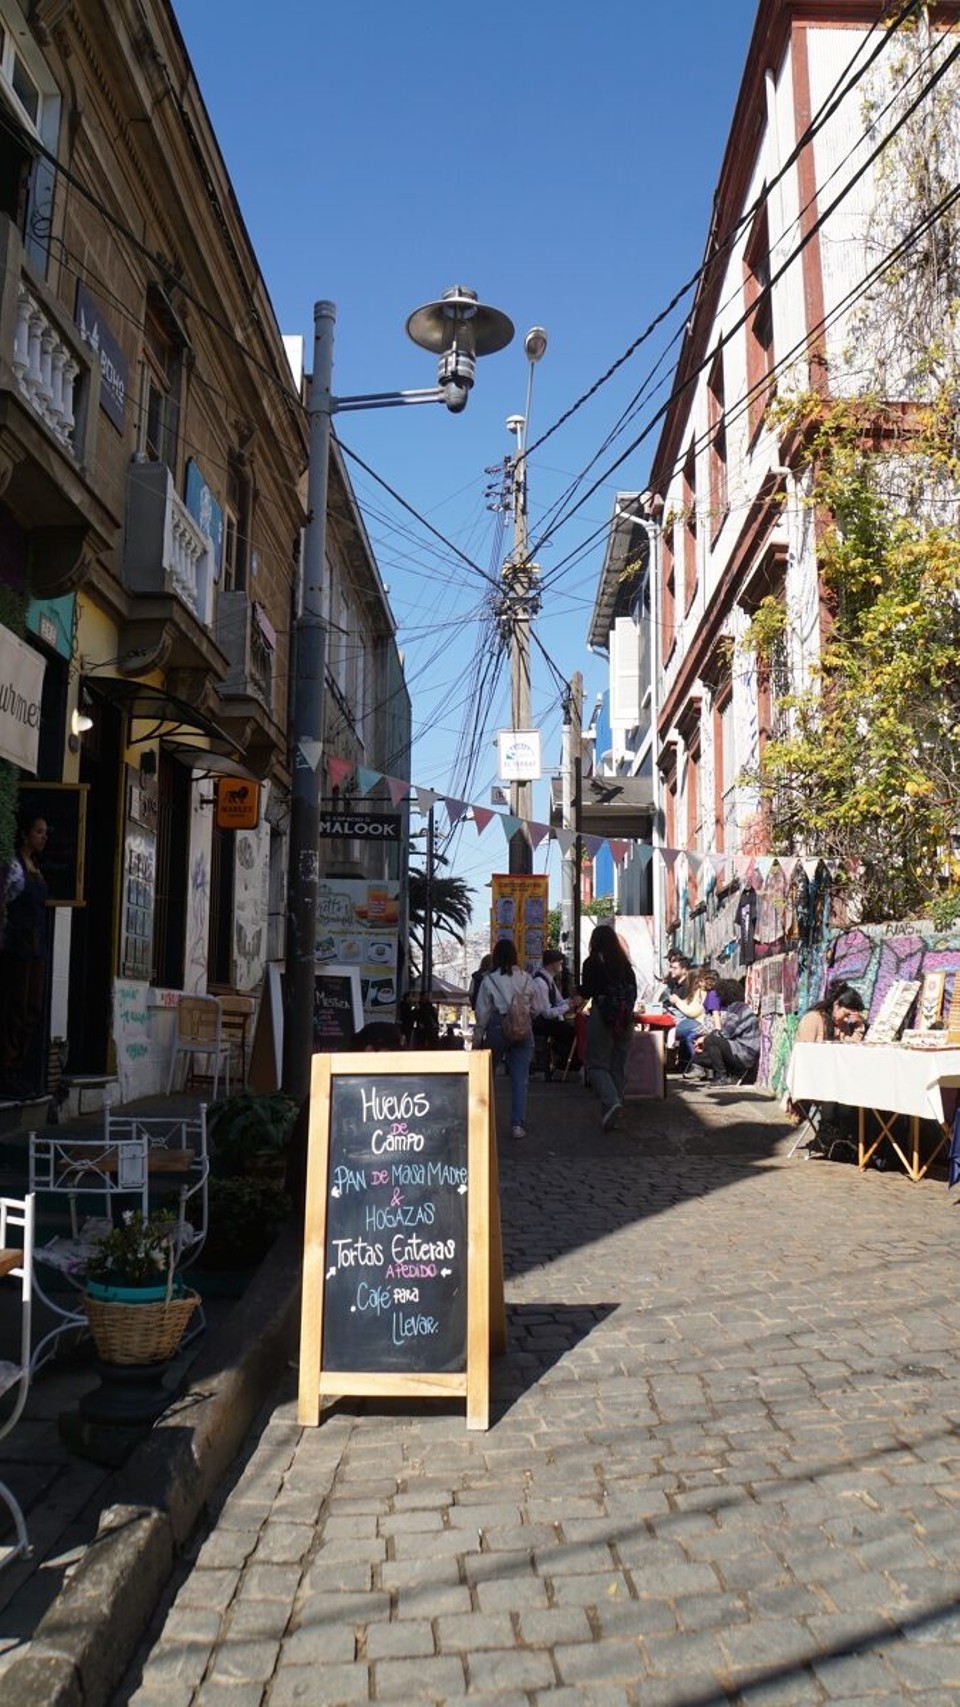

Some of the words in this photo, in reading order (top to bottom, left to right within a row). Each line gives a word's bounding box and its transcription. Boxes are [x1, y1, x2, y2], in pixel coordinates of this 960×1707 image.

[319, 821, 396, 835] MALOOK
[334, 1165, 367, 1194] PAN
[390, 1187, 405, 1206] &
[366, 1202, 435, 1232] HOGAZAS
[332, 1236, 384, 1269] Tortas
[391, 1232, 456, 1264] Enteras
[356, 1281, 392, 1316] Café
